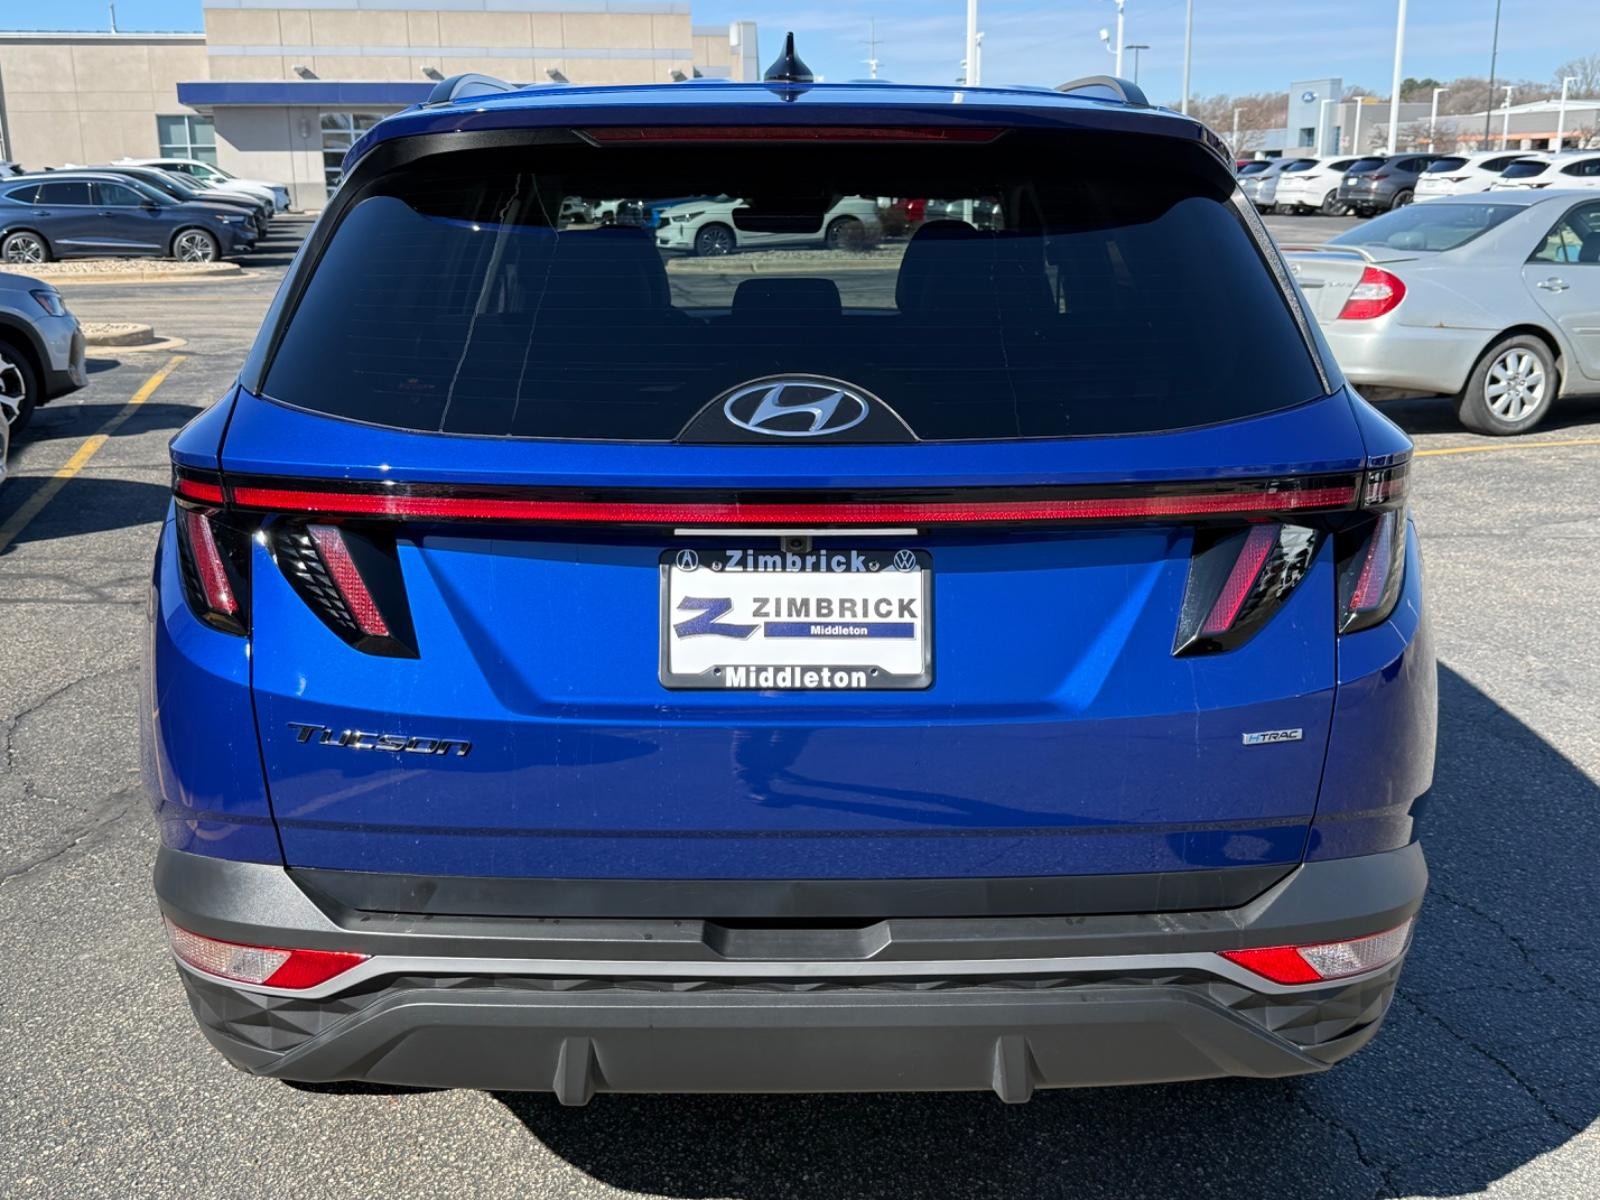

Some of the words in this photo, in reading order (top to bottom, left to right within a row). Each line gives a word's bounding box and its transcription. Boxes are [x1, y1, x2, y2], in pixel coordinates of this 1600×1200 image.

[725, 550, 867, 571] Zimbrick
[752, 597, 918, 618] ZIMBRICK
[810, 624, 868, 636] Middleton
[725, 666, 867, 688] Middleton
[1248, 730, 1298, 742] HTRAC
